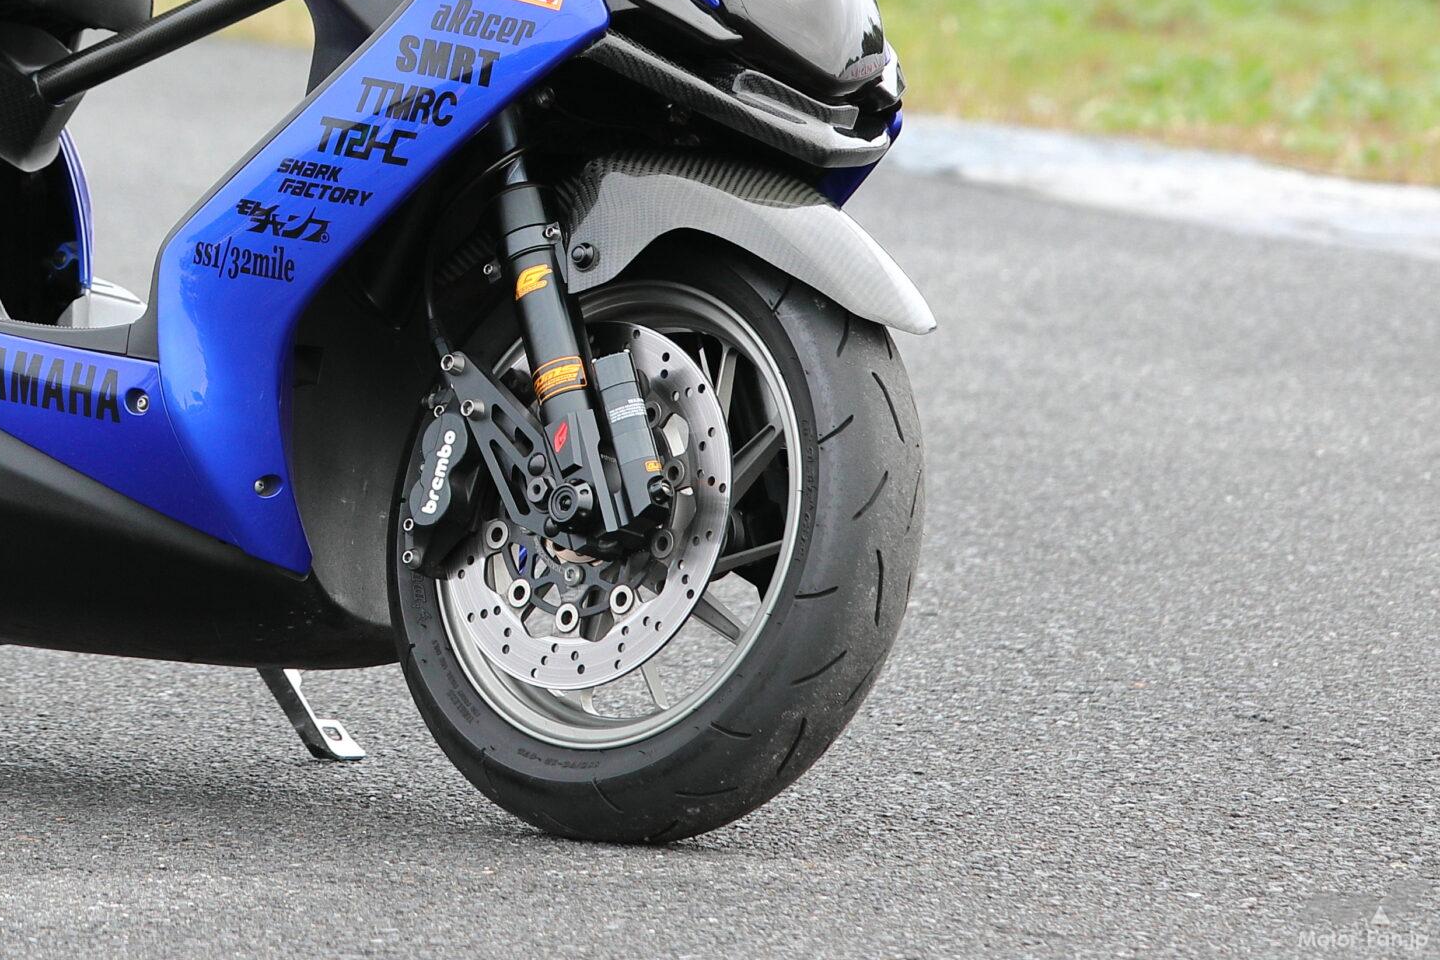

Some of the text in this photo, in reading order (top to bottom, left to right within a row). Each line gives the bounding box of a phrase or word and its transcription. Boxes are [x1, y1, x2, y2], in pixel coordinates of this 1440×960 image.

[395, 34, 501, 87] SMRT
[356, 76, 458, 127] TTMRC
[421, 430, 456, 515] brembo
